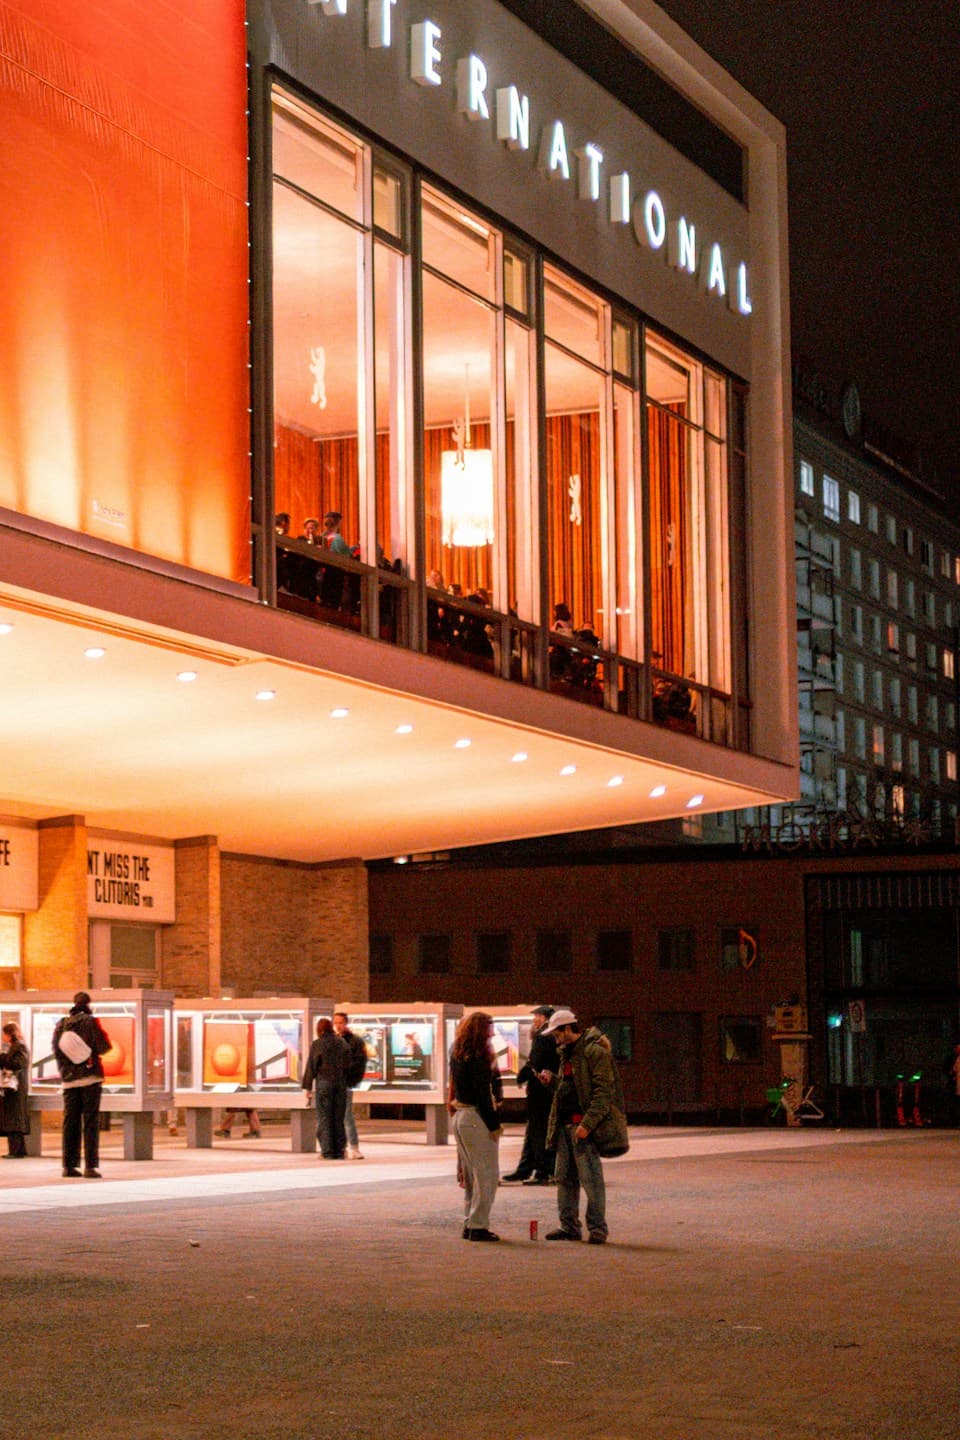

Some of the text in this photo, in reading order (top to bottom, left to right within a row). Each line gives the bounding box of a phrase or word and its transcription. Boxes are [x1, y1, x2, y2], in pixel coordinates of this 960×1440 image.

[104, 851, 129, 878] MISS
[132, 855, 150, 882] THE
[95, 878, 140, 907] CLITORIS
